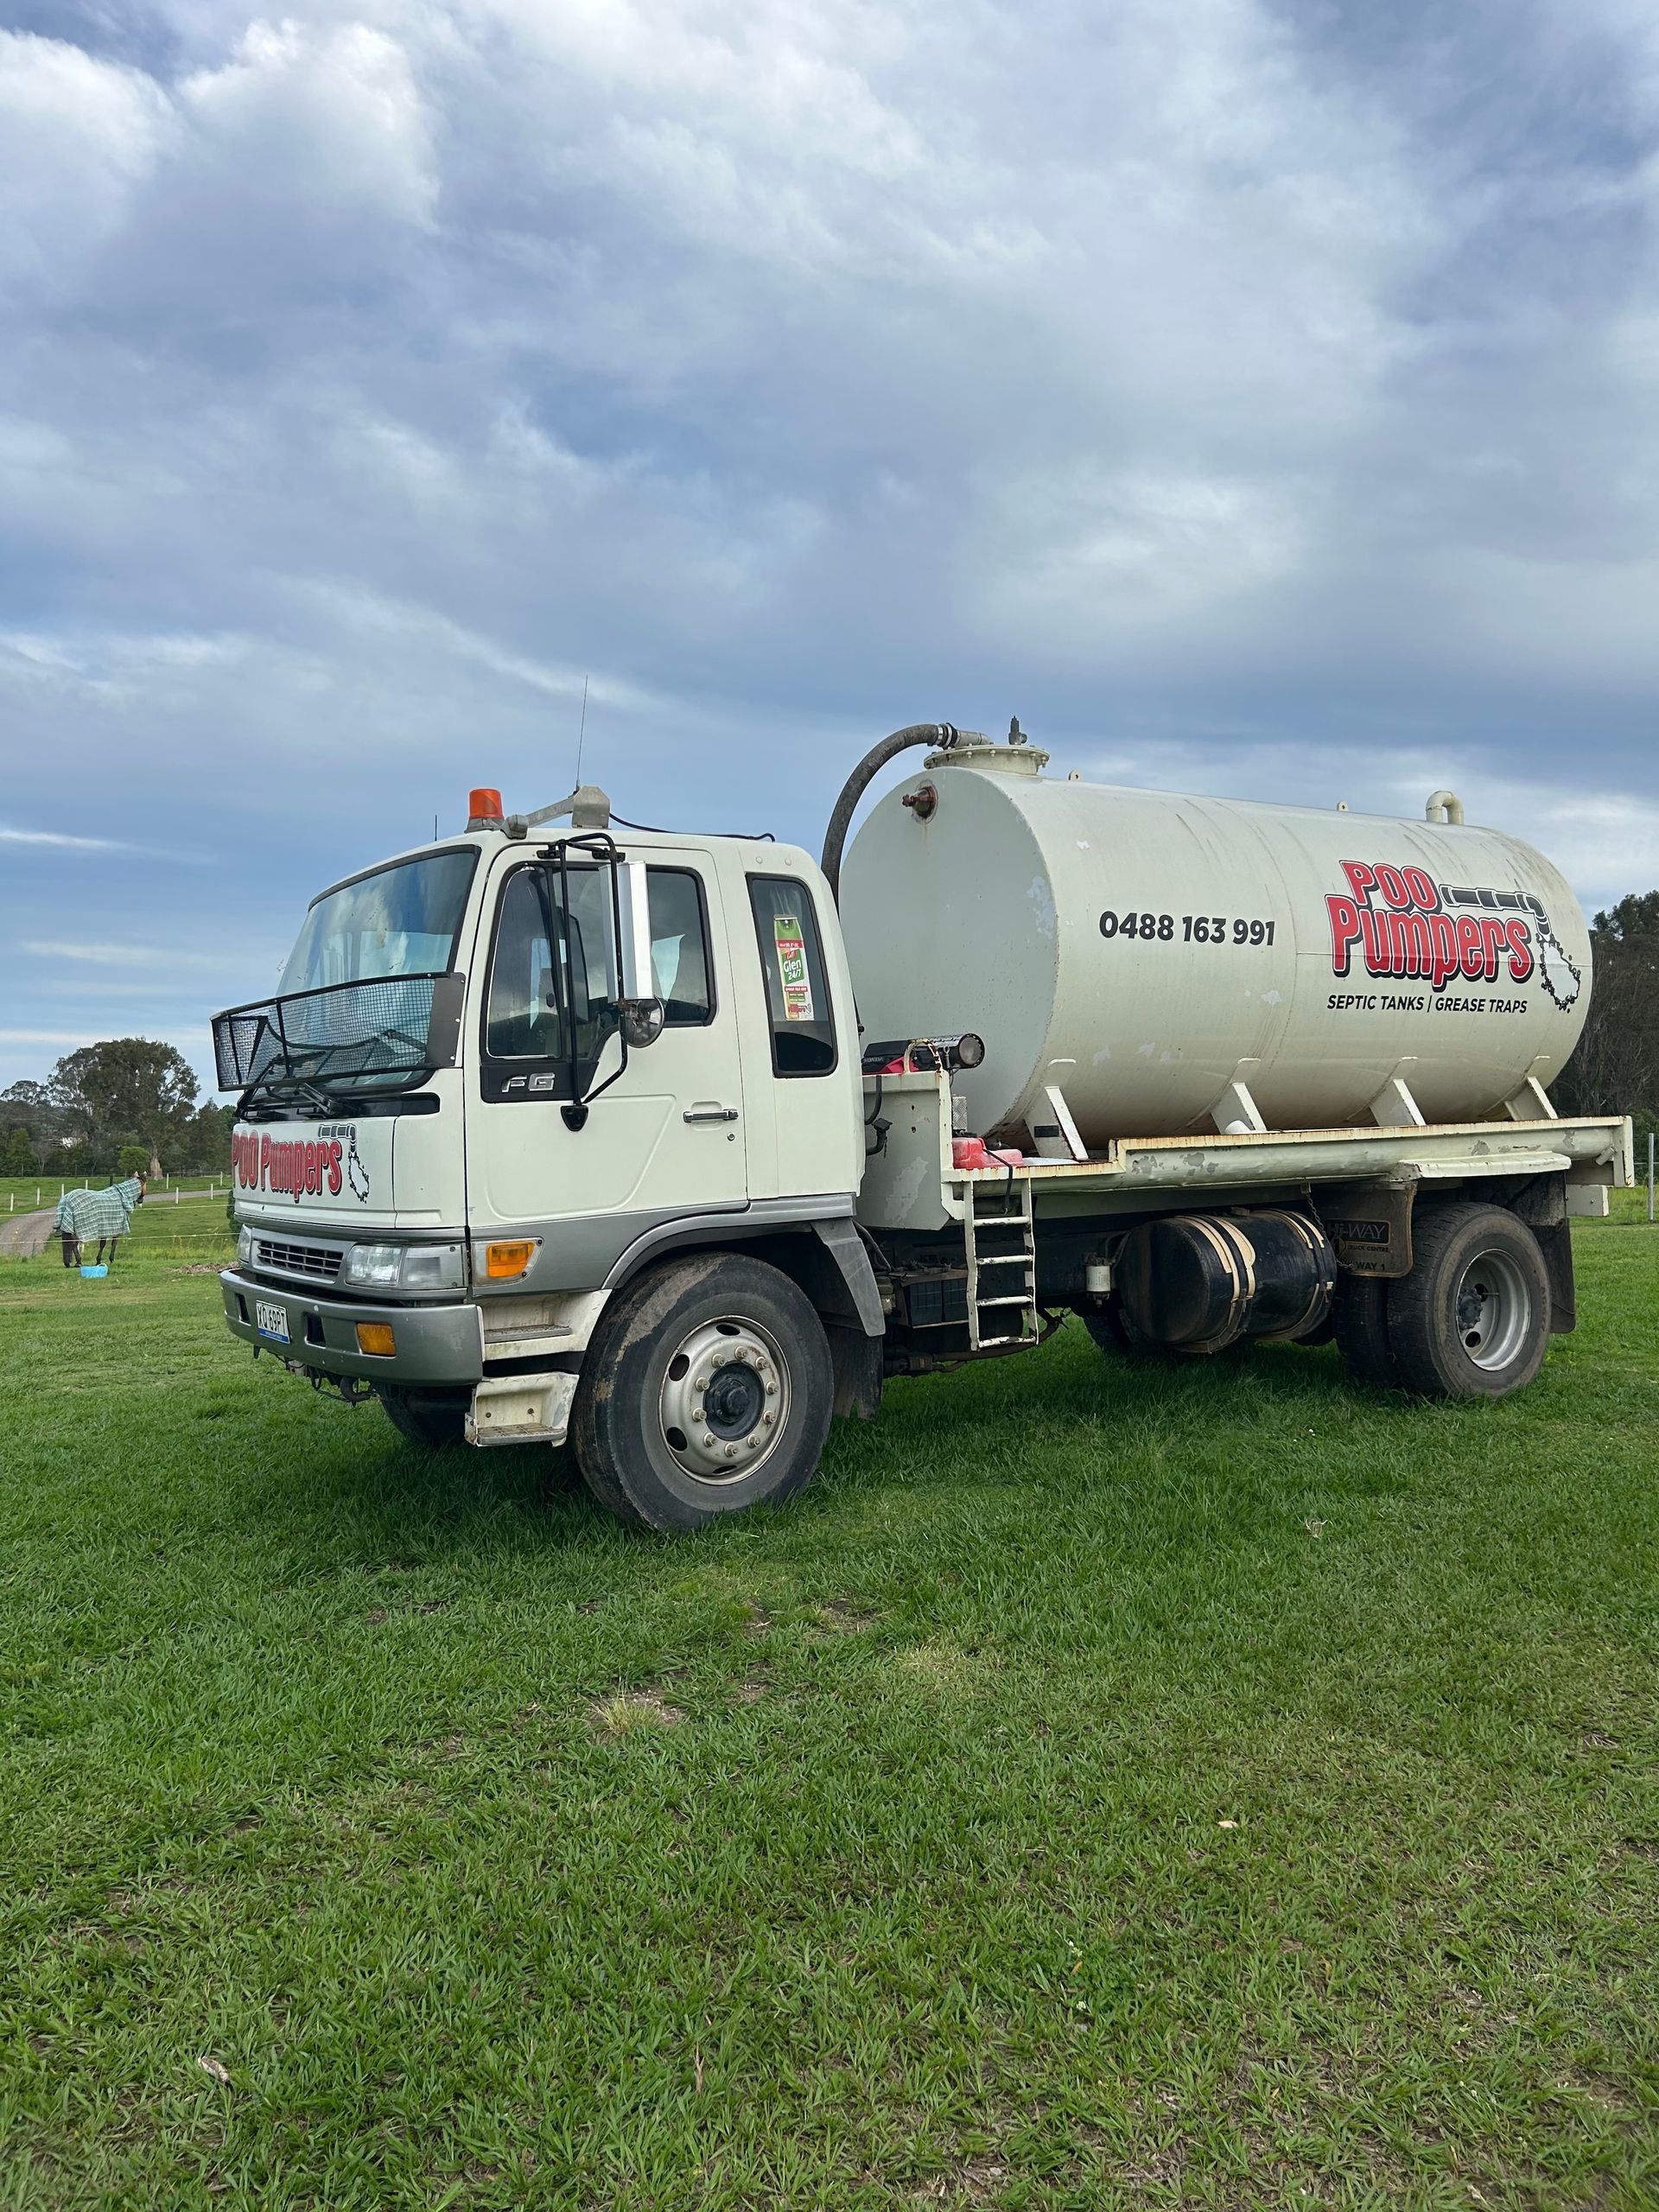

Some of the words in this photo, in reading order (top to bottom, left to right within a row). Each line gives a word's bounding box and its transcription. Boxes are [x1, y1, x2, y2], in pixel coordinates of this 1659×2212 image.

[1339, 860, 1442, 913] POO
[1099, 911, 1174, 941] 0488
[1182, 916, 1226, 944] 163
[1232, 918, 1274, 946] 991
[1325, 894, 1535, 993] Pumpers
[784, 959, 802, 972] Glen
[787, 969, 802, 981] 24/7
[1326, 995, 1376, 1010] SEPTIC
[1381, 995, 1424, 1011] TANKS
[1435, 997, 1485, 1013] GREASE
[1489, 999, 1528, 1014] TRAPS
[501, 1072, 555, 1093] FG
[260, 1133, 343, 1204] Pumpers
